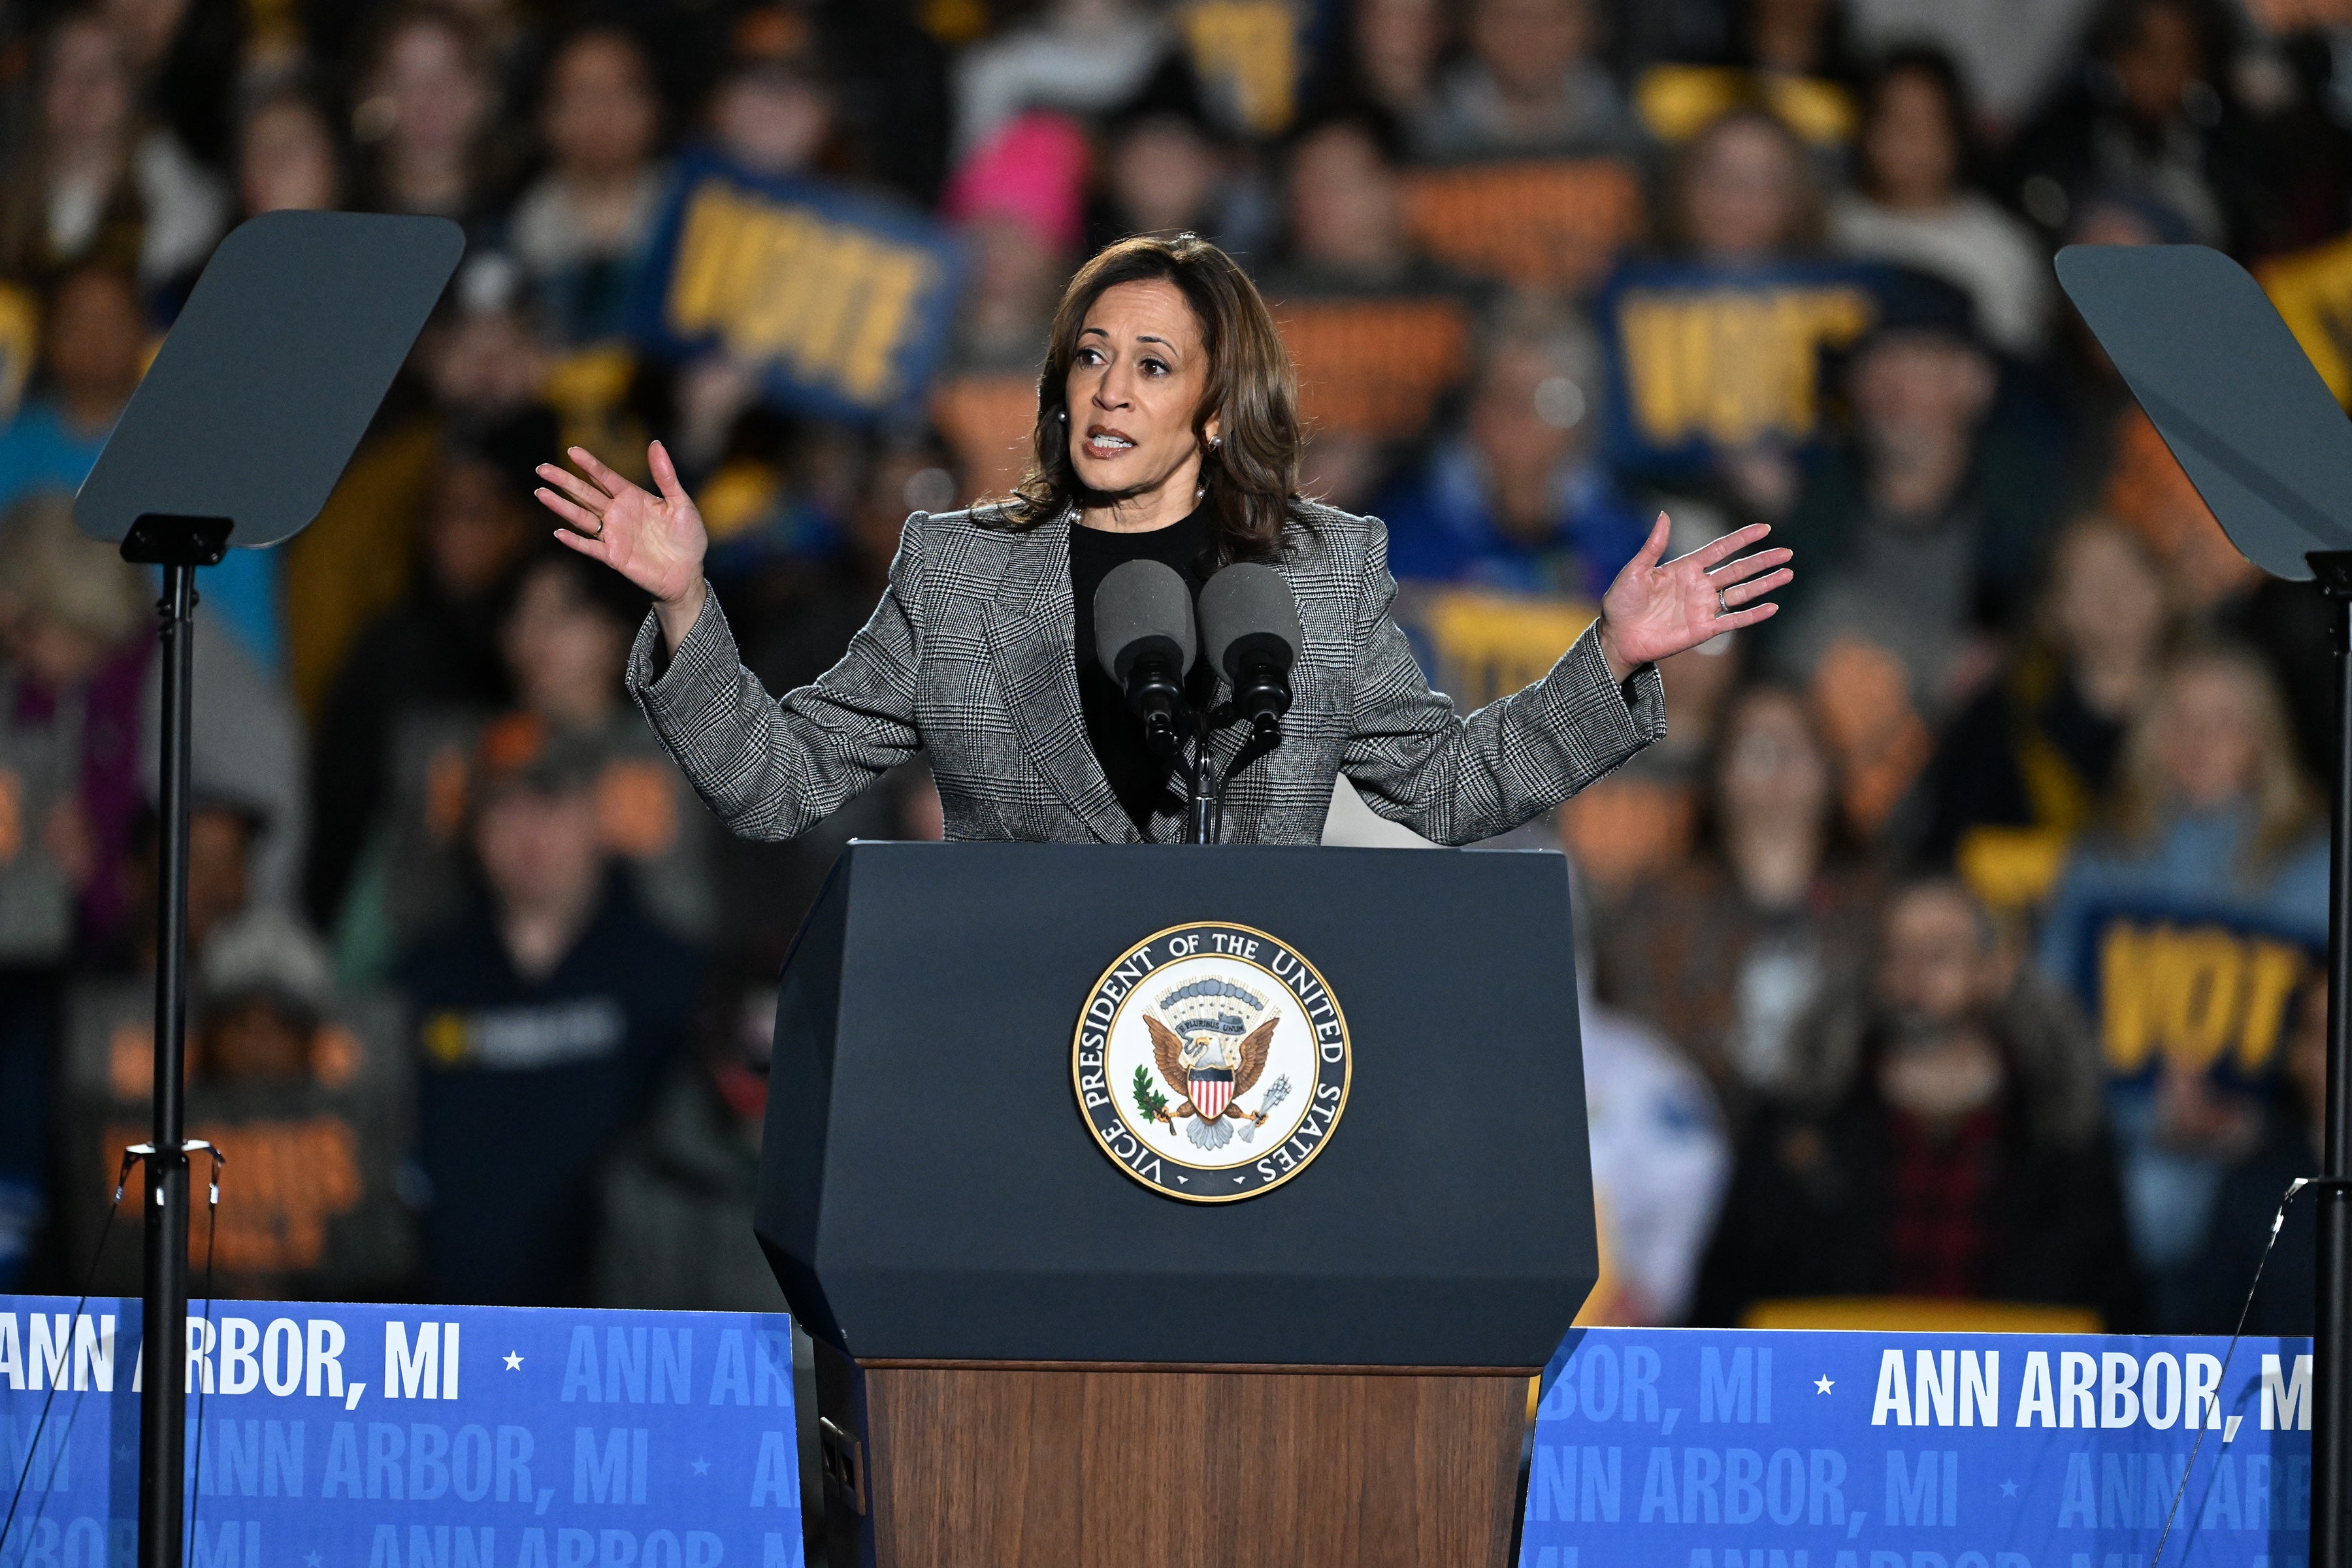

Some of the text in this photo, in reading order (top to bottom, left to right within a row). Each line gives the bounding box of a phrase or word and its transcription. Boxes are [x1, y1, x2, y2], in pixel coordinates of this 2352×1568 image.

[1080, 933, 1343, 1184] VICE PRESIDENT OF THE UNITED STATES
[1185, 1020, 1219, 1030] PLURIBUS
[0, 1312, 461, 1411] ANN RBOR, MI
[559, 1324, 693, 1405] ANN
[1699, 1346, 1773, 1424] MI
[1870, 1348, 2001, 1428] ANN
[2015, 1350, 2242, 1443] ARBOR,
[321, 1421, 555, 1516] ARBOR,
[573, 1426, 649, 1505] MI
[1526, 1445, 1958, 1539] NN ARBOR, MI
[2057, 1450, 2186, 1530] ANN
